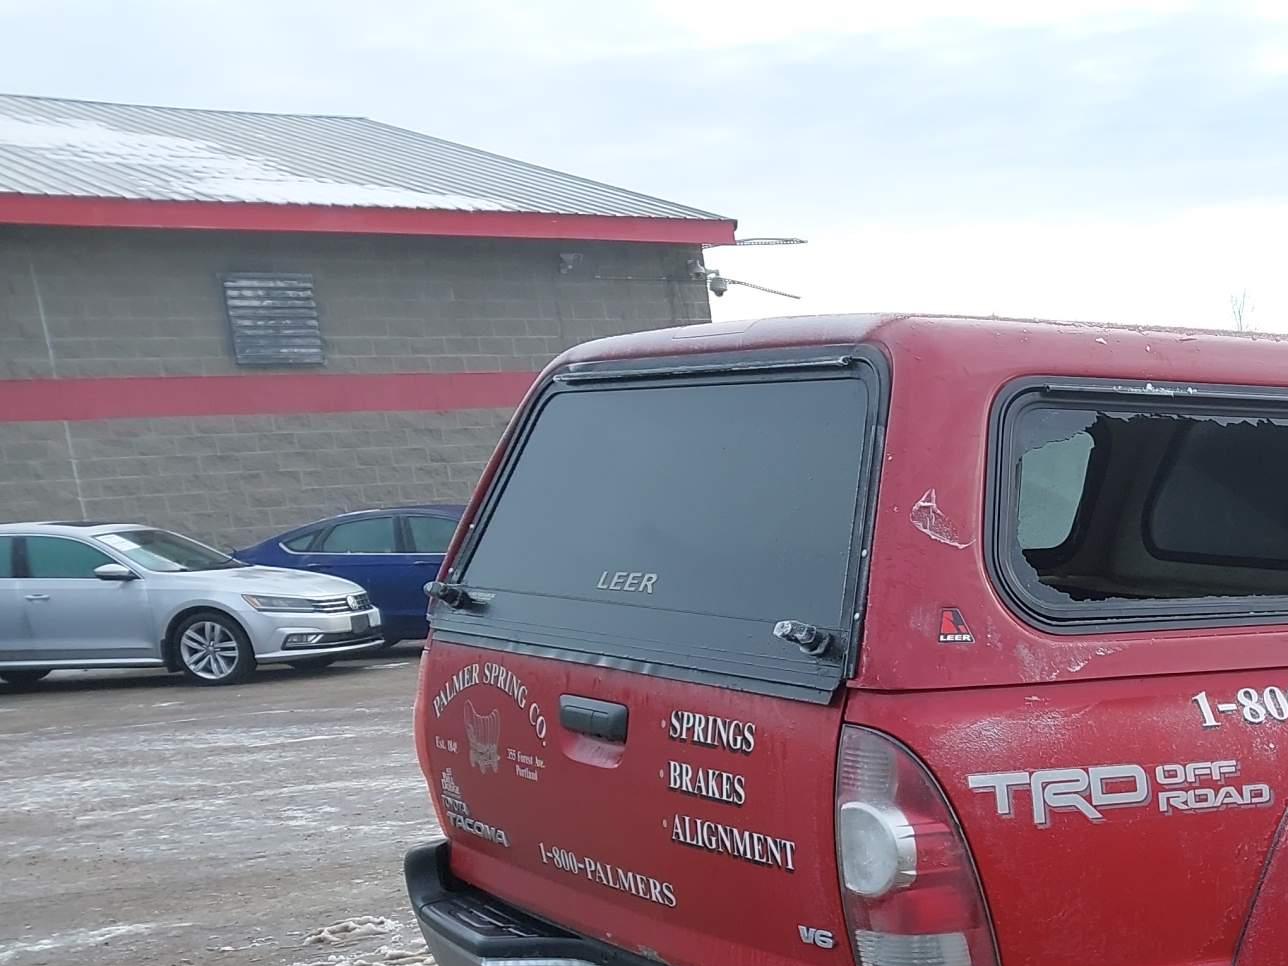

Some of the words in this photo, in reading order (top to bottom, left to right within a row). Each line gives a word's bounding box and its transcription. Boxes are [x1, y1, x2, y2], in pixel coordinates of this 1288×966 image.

[595, 570, 659, 595] LEER
[940, 634, 972, 642] LEER
[432, 664, 480, 718] PALMER
[482, 662, 528, 708] SPRING
[669, 709, 757, 753] SPRINGS
[668, 760, 747, 805] BRAKES
[1155, 760, 1239, 785] OFF
[967, 764, 1150, 826] TRD
[1157, 783, 1272, 814] ROAD
[446, 811, 510, 847] TACOMA
[671, 813, 797, 871] ALIGNMENT
[538, 841, 678, 908] 1-800-PALMERS
[798, 925, 835, 950] V6
